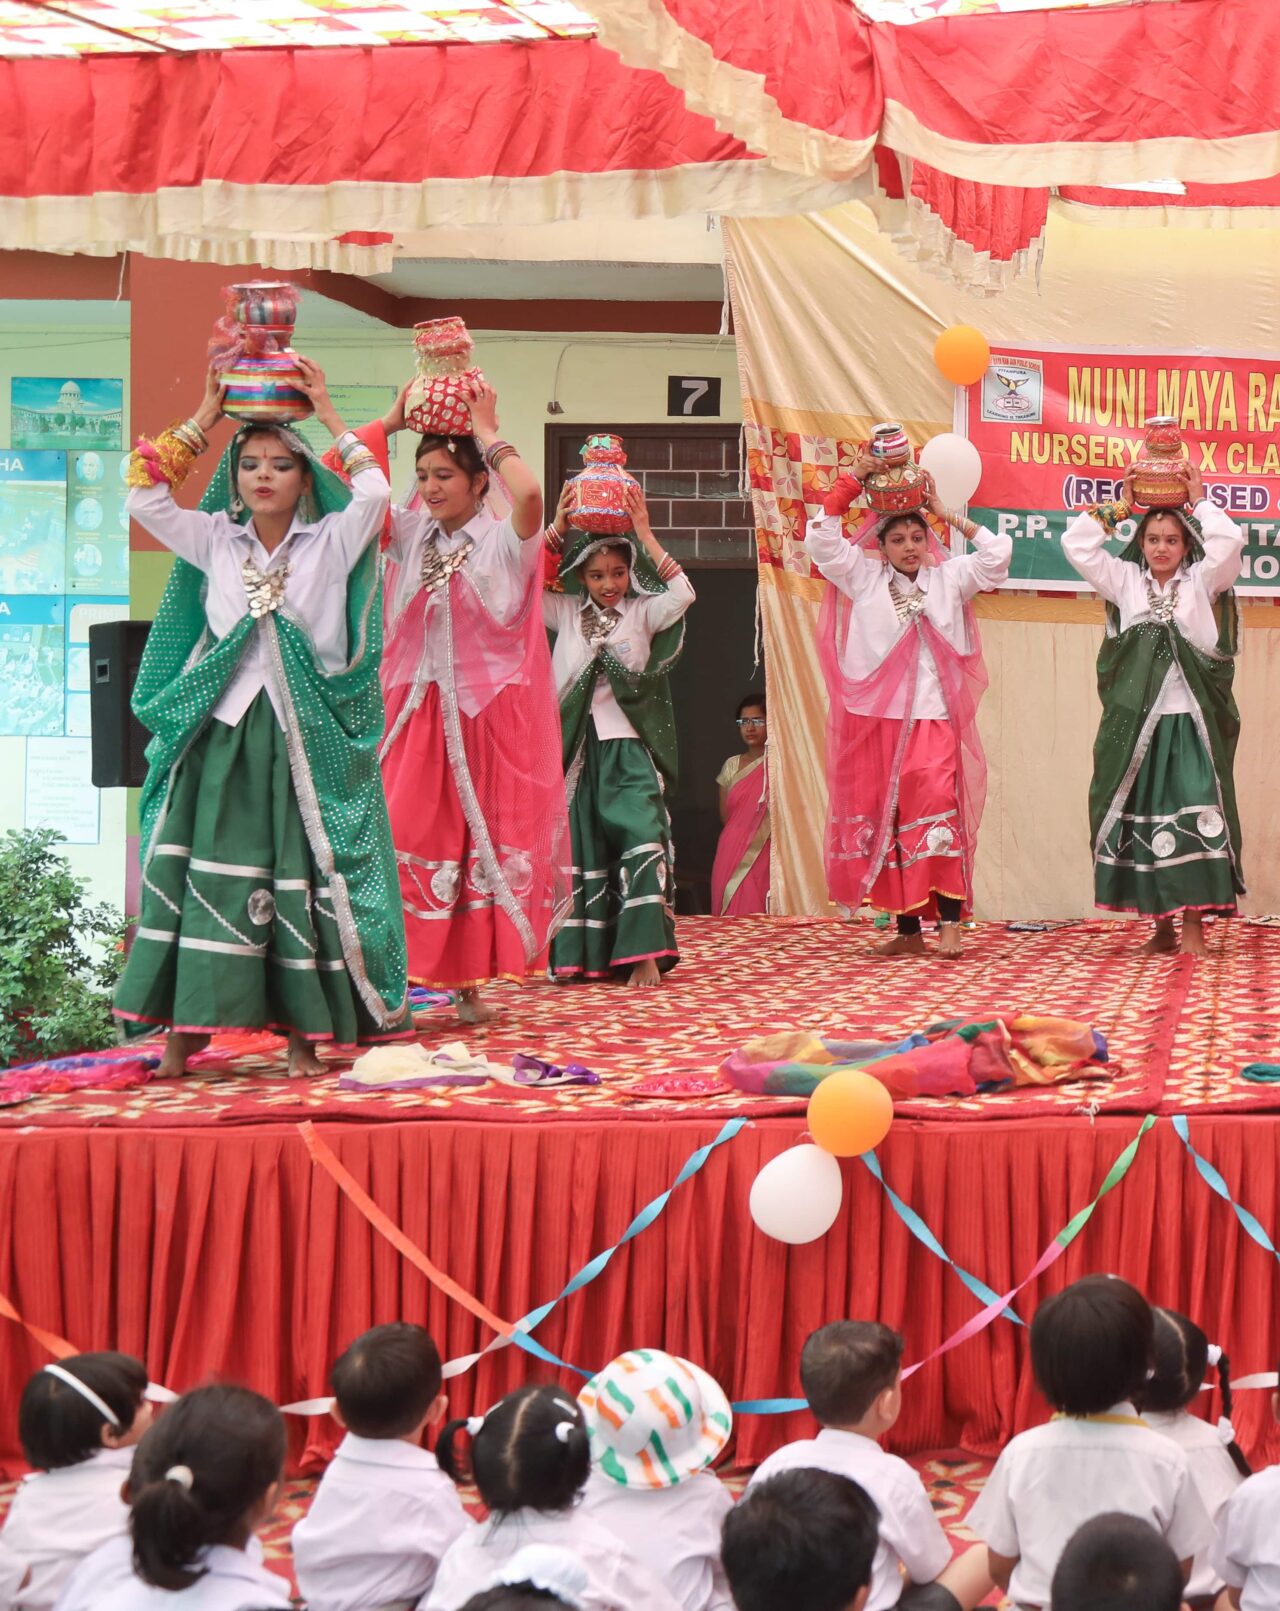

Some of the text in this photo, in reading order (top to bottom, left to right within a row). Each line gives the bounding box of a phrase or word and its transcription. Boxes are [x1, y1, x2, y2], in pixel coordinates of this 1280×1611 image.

[681, 380, 709, 414] 7
[1067, 366, 1146, 429] MUNI
[1156, 369, 1238, 432] MAYA
[1009, 432, 1145, 468] NURSERY
[1199, 441, 1218, 472] X
[997, 513, 1052, 539] P.P.
